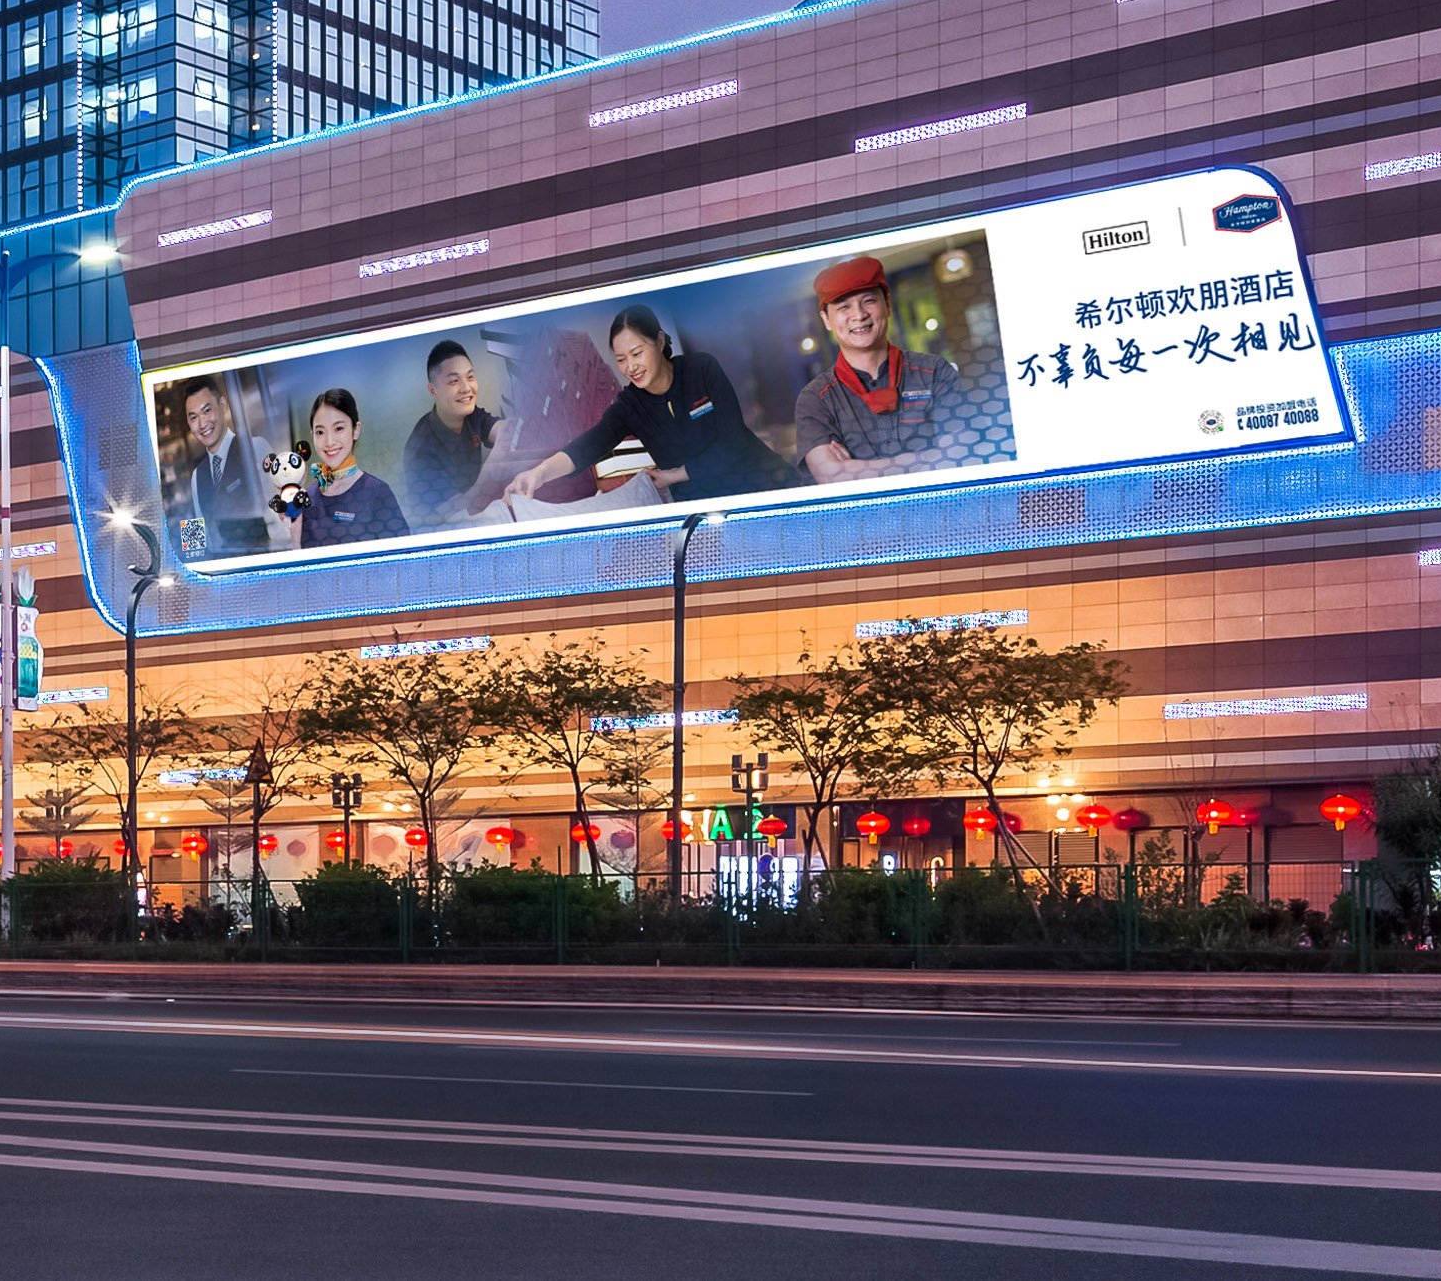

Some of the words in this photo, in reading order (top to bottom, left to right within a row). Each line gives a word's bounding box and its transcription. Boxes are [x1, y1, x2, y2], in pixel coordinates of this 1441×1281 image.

[1218, 201, 1274, 219] Hampton
[1088, 229, 1145, 250] Hilton
[1074, 269, 1295, 330] 希尔顿欢朋酒店
[1017, 312, 1317, 389] 不辜负每一次相见
[1236, 396, 1318, 417] 品牌投资加盟电话
[1246, 412, 1279, 431] 40087
[1283, 407, 1320, 426] 40088
